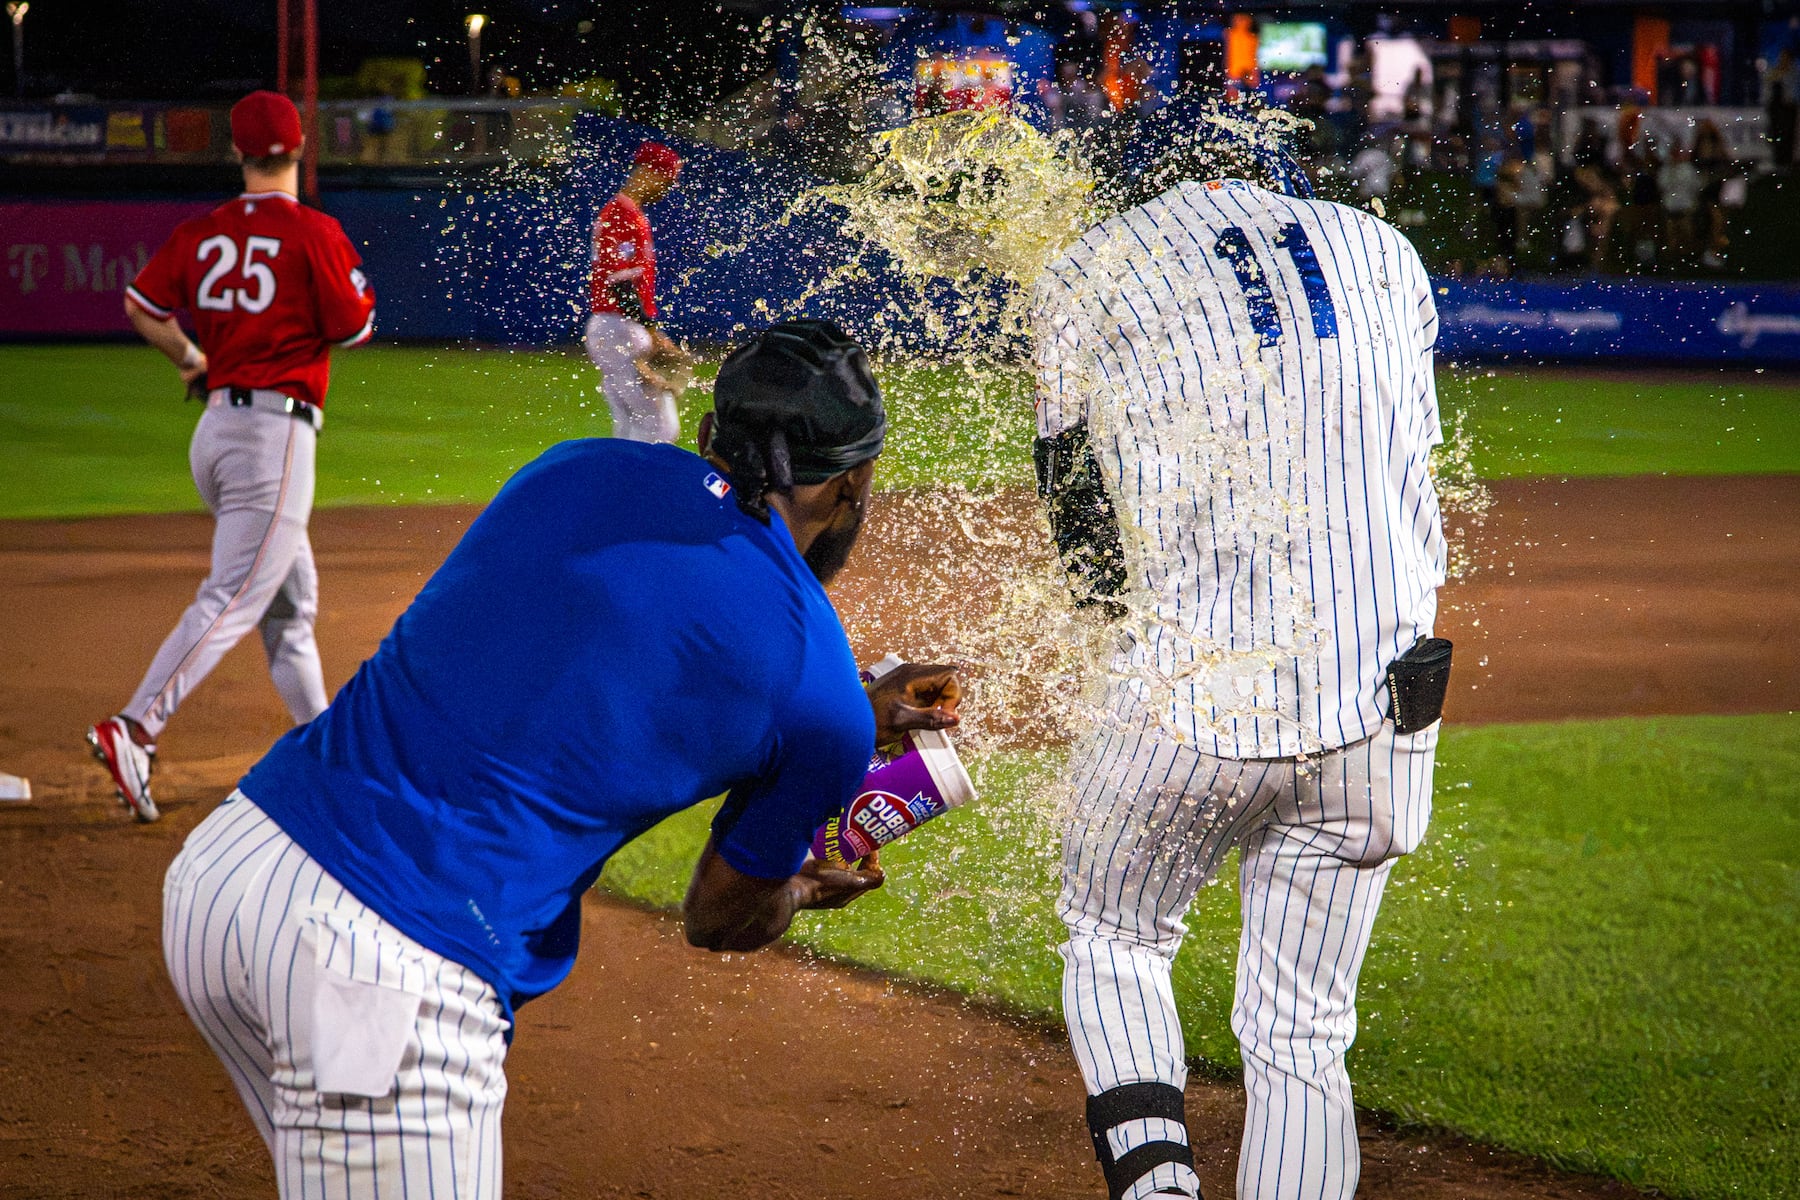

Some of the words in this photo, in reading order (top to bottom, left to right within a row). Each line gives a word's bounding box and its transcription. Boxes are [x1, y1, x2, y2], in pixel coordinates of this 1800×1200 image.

[196, 233, 281, 314] 25
[1213, 222, 1339, 348] 11
[1388, 672, 1402, 727] EVOSHIELD
[825, 817, 840, 838] FUN
